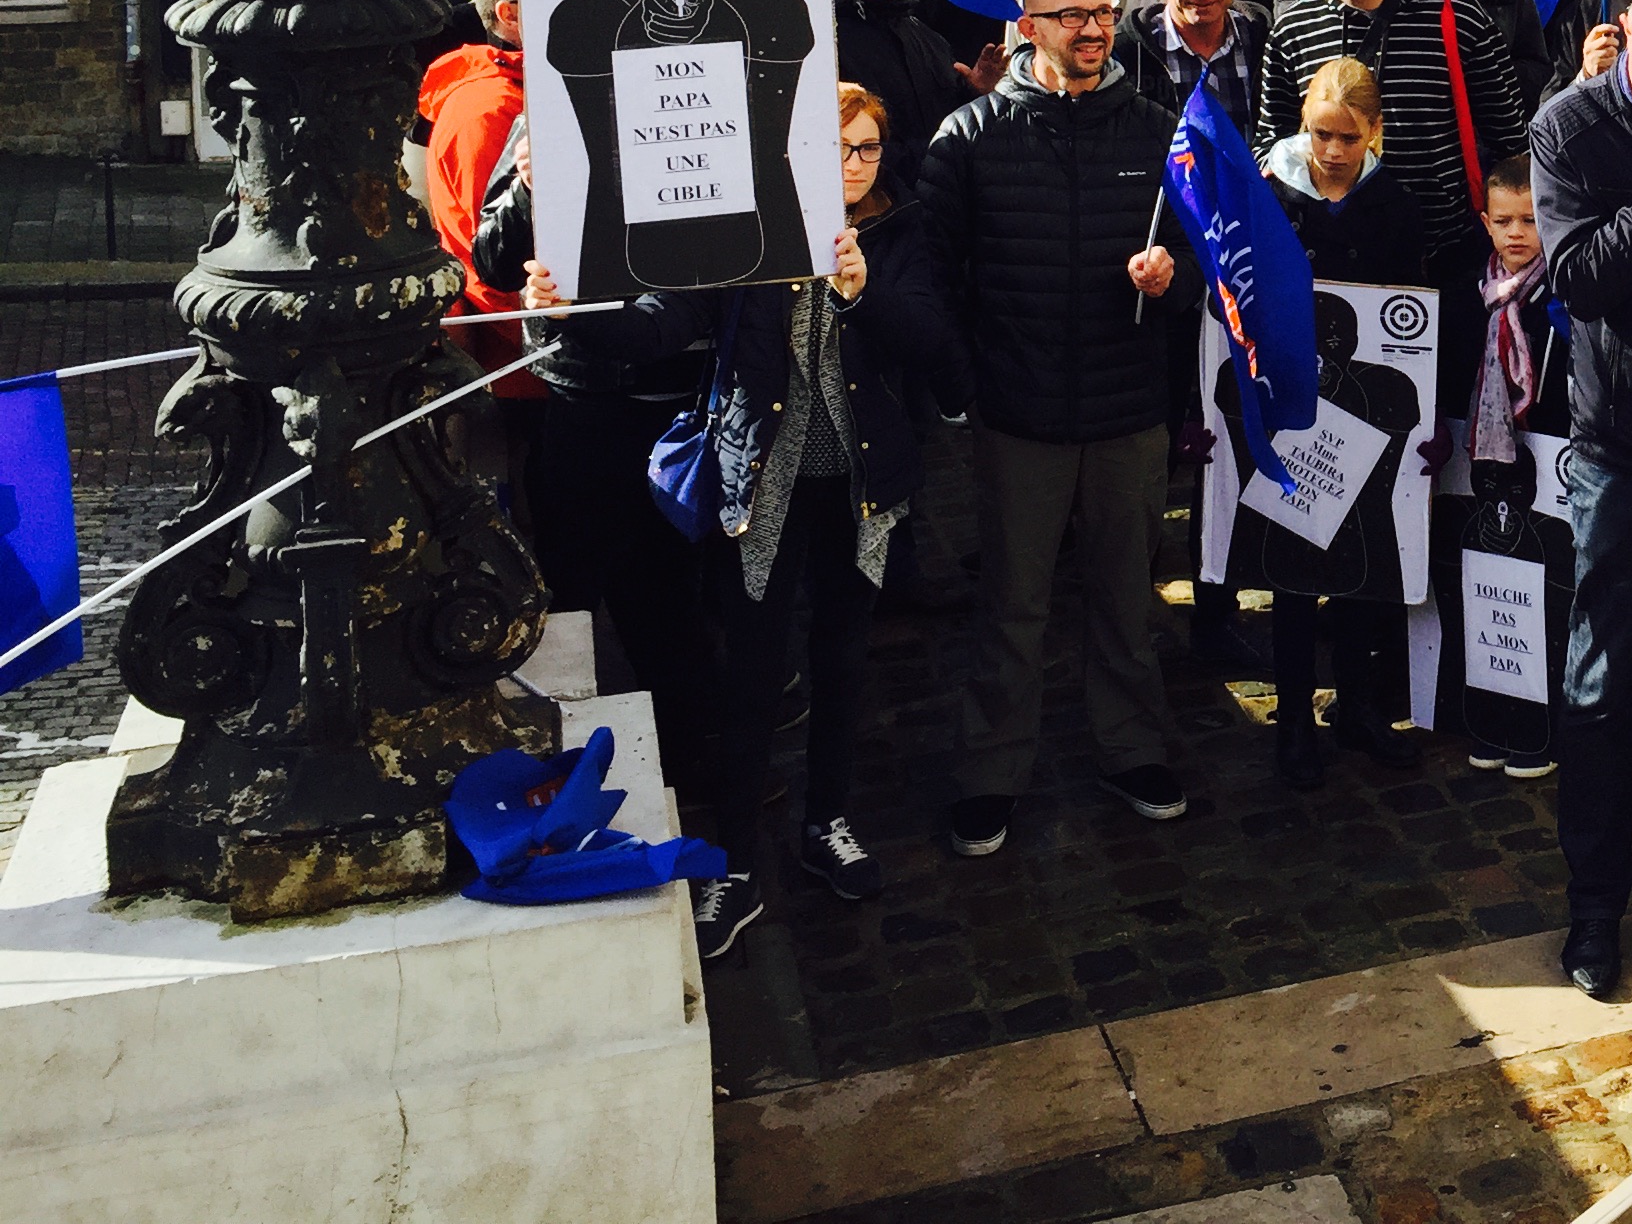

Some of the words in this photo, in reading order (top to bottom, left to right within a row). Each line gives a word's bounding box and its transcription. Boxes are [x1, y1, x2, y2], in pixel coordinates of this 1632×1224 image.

[655, 60, 705, 79] MON
[659, 91, 711, 109] PAPA
[633, 123, 693, 143] N'EST
[699, 119, 737, 137] PAS
[666, 153, 710, 171] UNE
[657, 182, 723, 203] CIBLE
[1320, 428, 1345, 448] SVP
[1312, 440, 1339, 464] Mme
[1289, 445, 1345, 483] TAUBIRA
[1279, 454, 1346, 500] PROTEGEZ
[1473, 582, 1533, 606] TOUCHE
[1491, 609, 1517, 627] PAS
[1477, 630, 1488, 644] A
[1497, 633, 1529, 651] MON
[1489, 654, 1523, 675] PAPA
